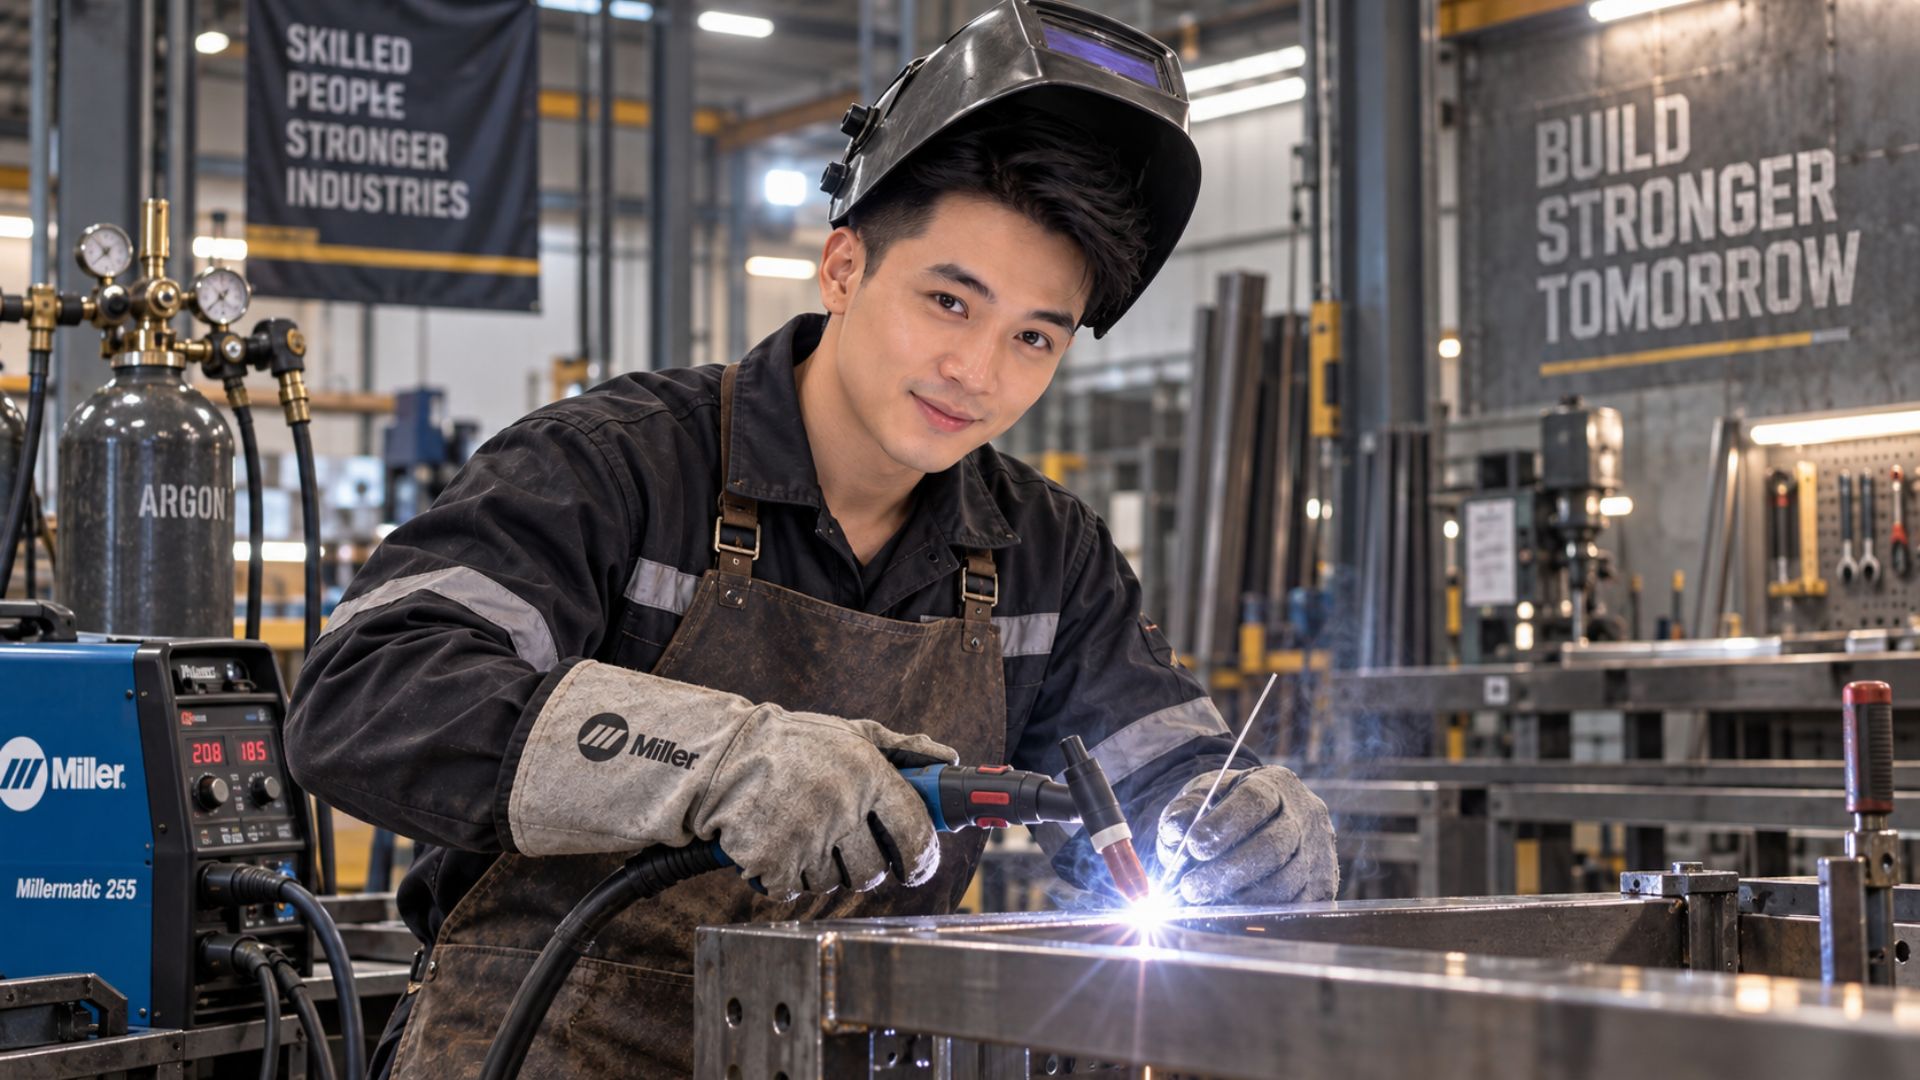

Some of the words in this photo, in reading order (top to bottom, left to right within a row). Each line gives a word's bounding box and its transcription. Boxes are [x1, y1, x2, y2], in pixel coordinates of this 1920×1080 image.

[286, 23, 412, 74] SKILLED
[286, 118, 449, 171] STRONGER
[1536, 93, 1690, 188] BUILD
[286, 167, 470, 219] INDUSTRIES
[1536, 147, 1838, 266] STRONGER
[1536, 229, 1861, 344] TOMORROW
[138, 483, 226, 520] ARGON
[192, 742, 222, 764] 208
[241, 740, 266, 761] 185
[15, 878, 101, 899] Millermatic
[105, 879, 137, 900] 255
